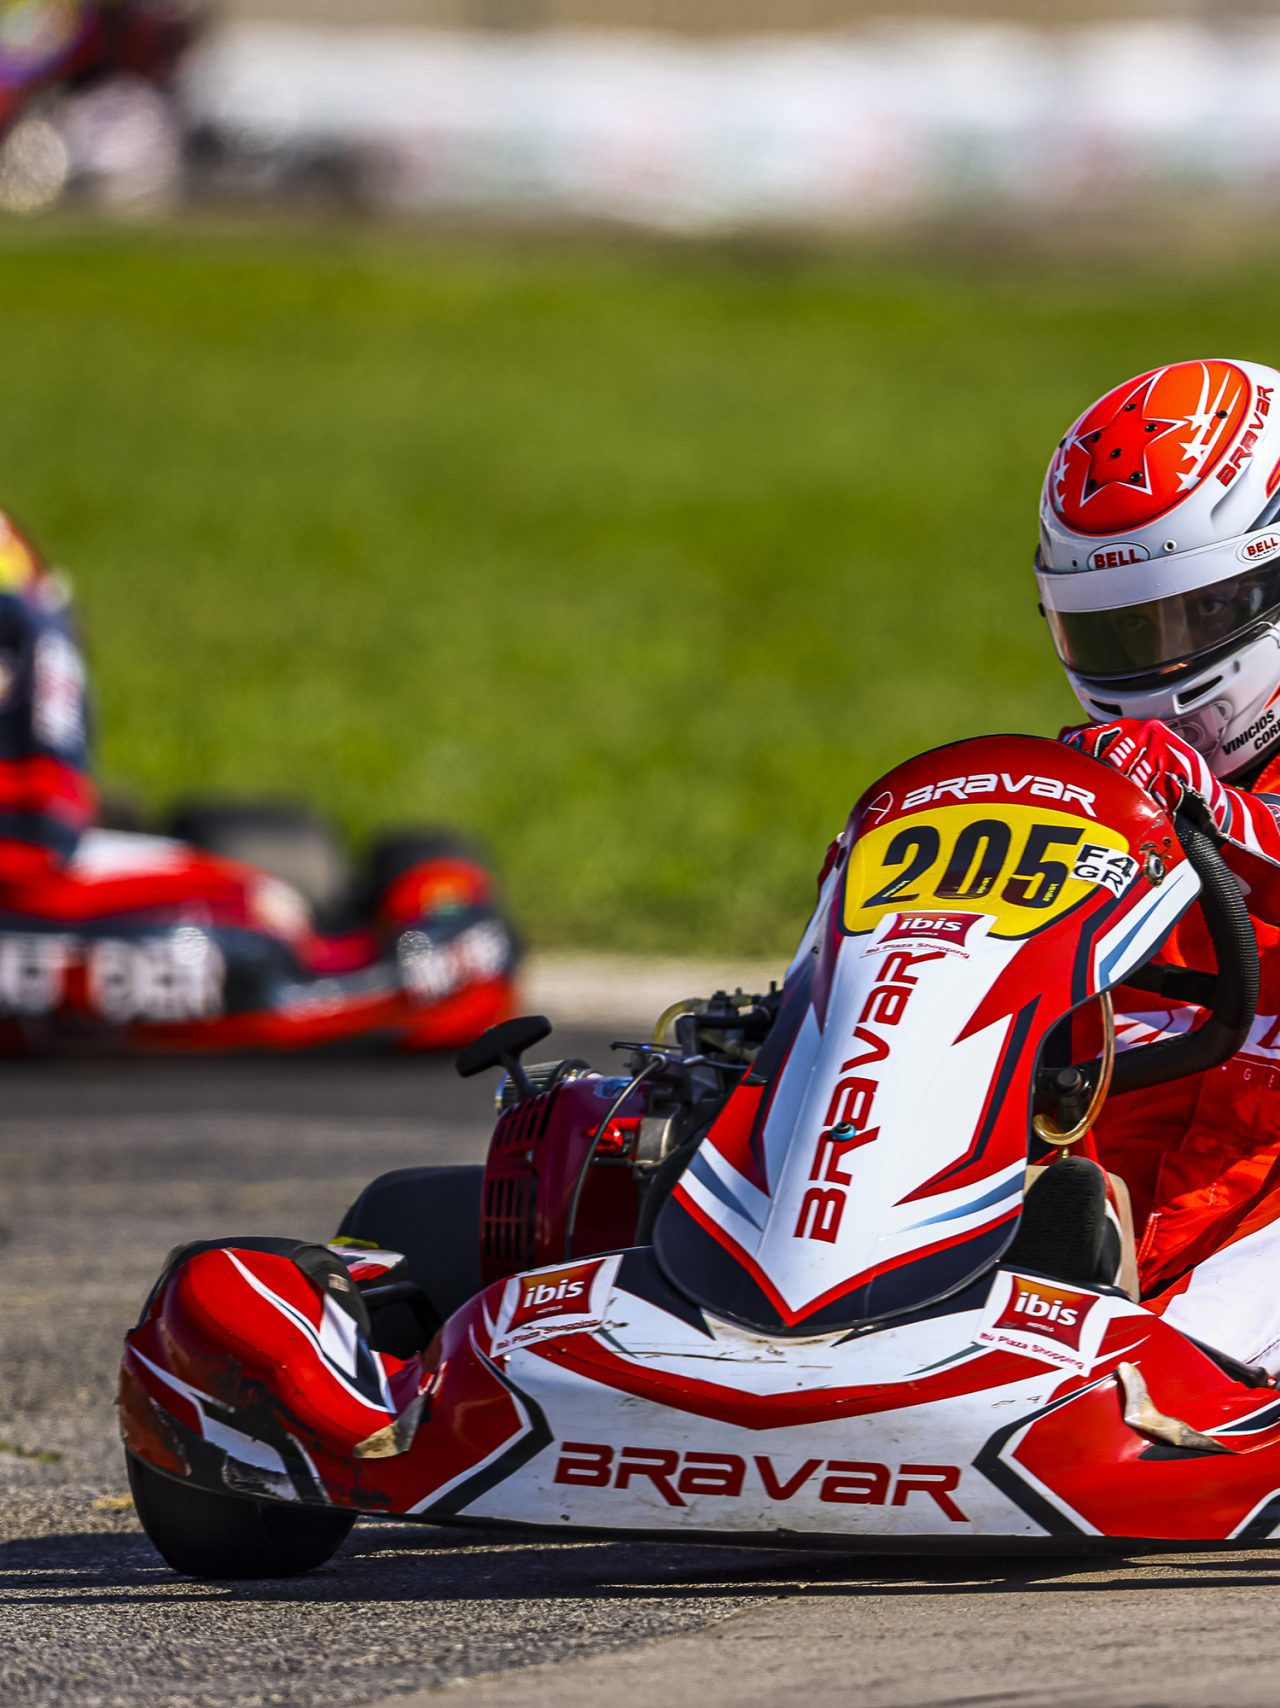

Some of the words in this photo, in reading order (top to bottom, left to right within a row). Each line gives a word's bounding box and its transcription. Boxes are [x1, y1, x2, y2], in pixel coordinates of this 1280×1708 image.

[1216, 385, 1274, 487] BRAVAR
[1093, 548, 1141, 570] BELL
[1247, 537, 1279, 556] BELL
[1221, 709, 1276, 756] VINICIOS
[901, 772, 1097, 818] BRAVAR
[860, 819, 1086, 910] 205
[1076, 843, 1135, 878] F4
[1073, 864, 1124, 893] GR
[898, 917, 963, 932] ibis
[793, 951, 948, 1245] BRAVAR
[523, 1278, 585, 1309] ibis
[1014, 1291, 1079, 1326] ibis
[1031, 1344, 1085, 1371] Shopping
[553, 1440, 970, 1523] BRAVAR
